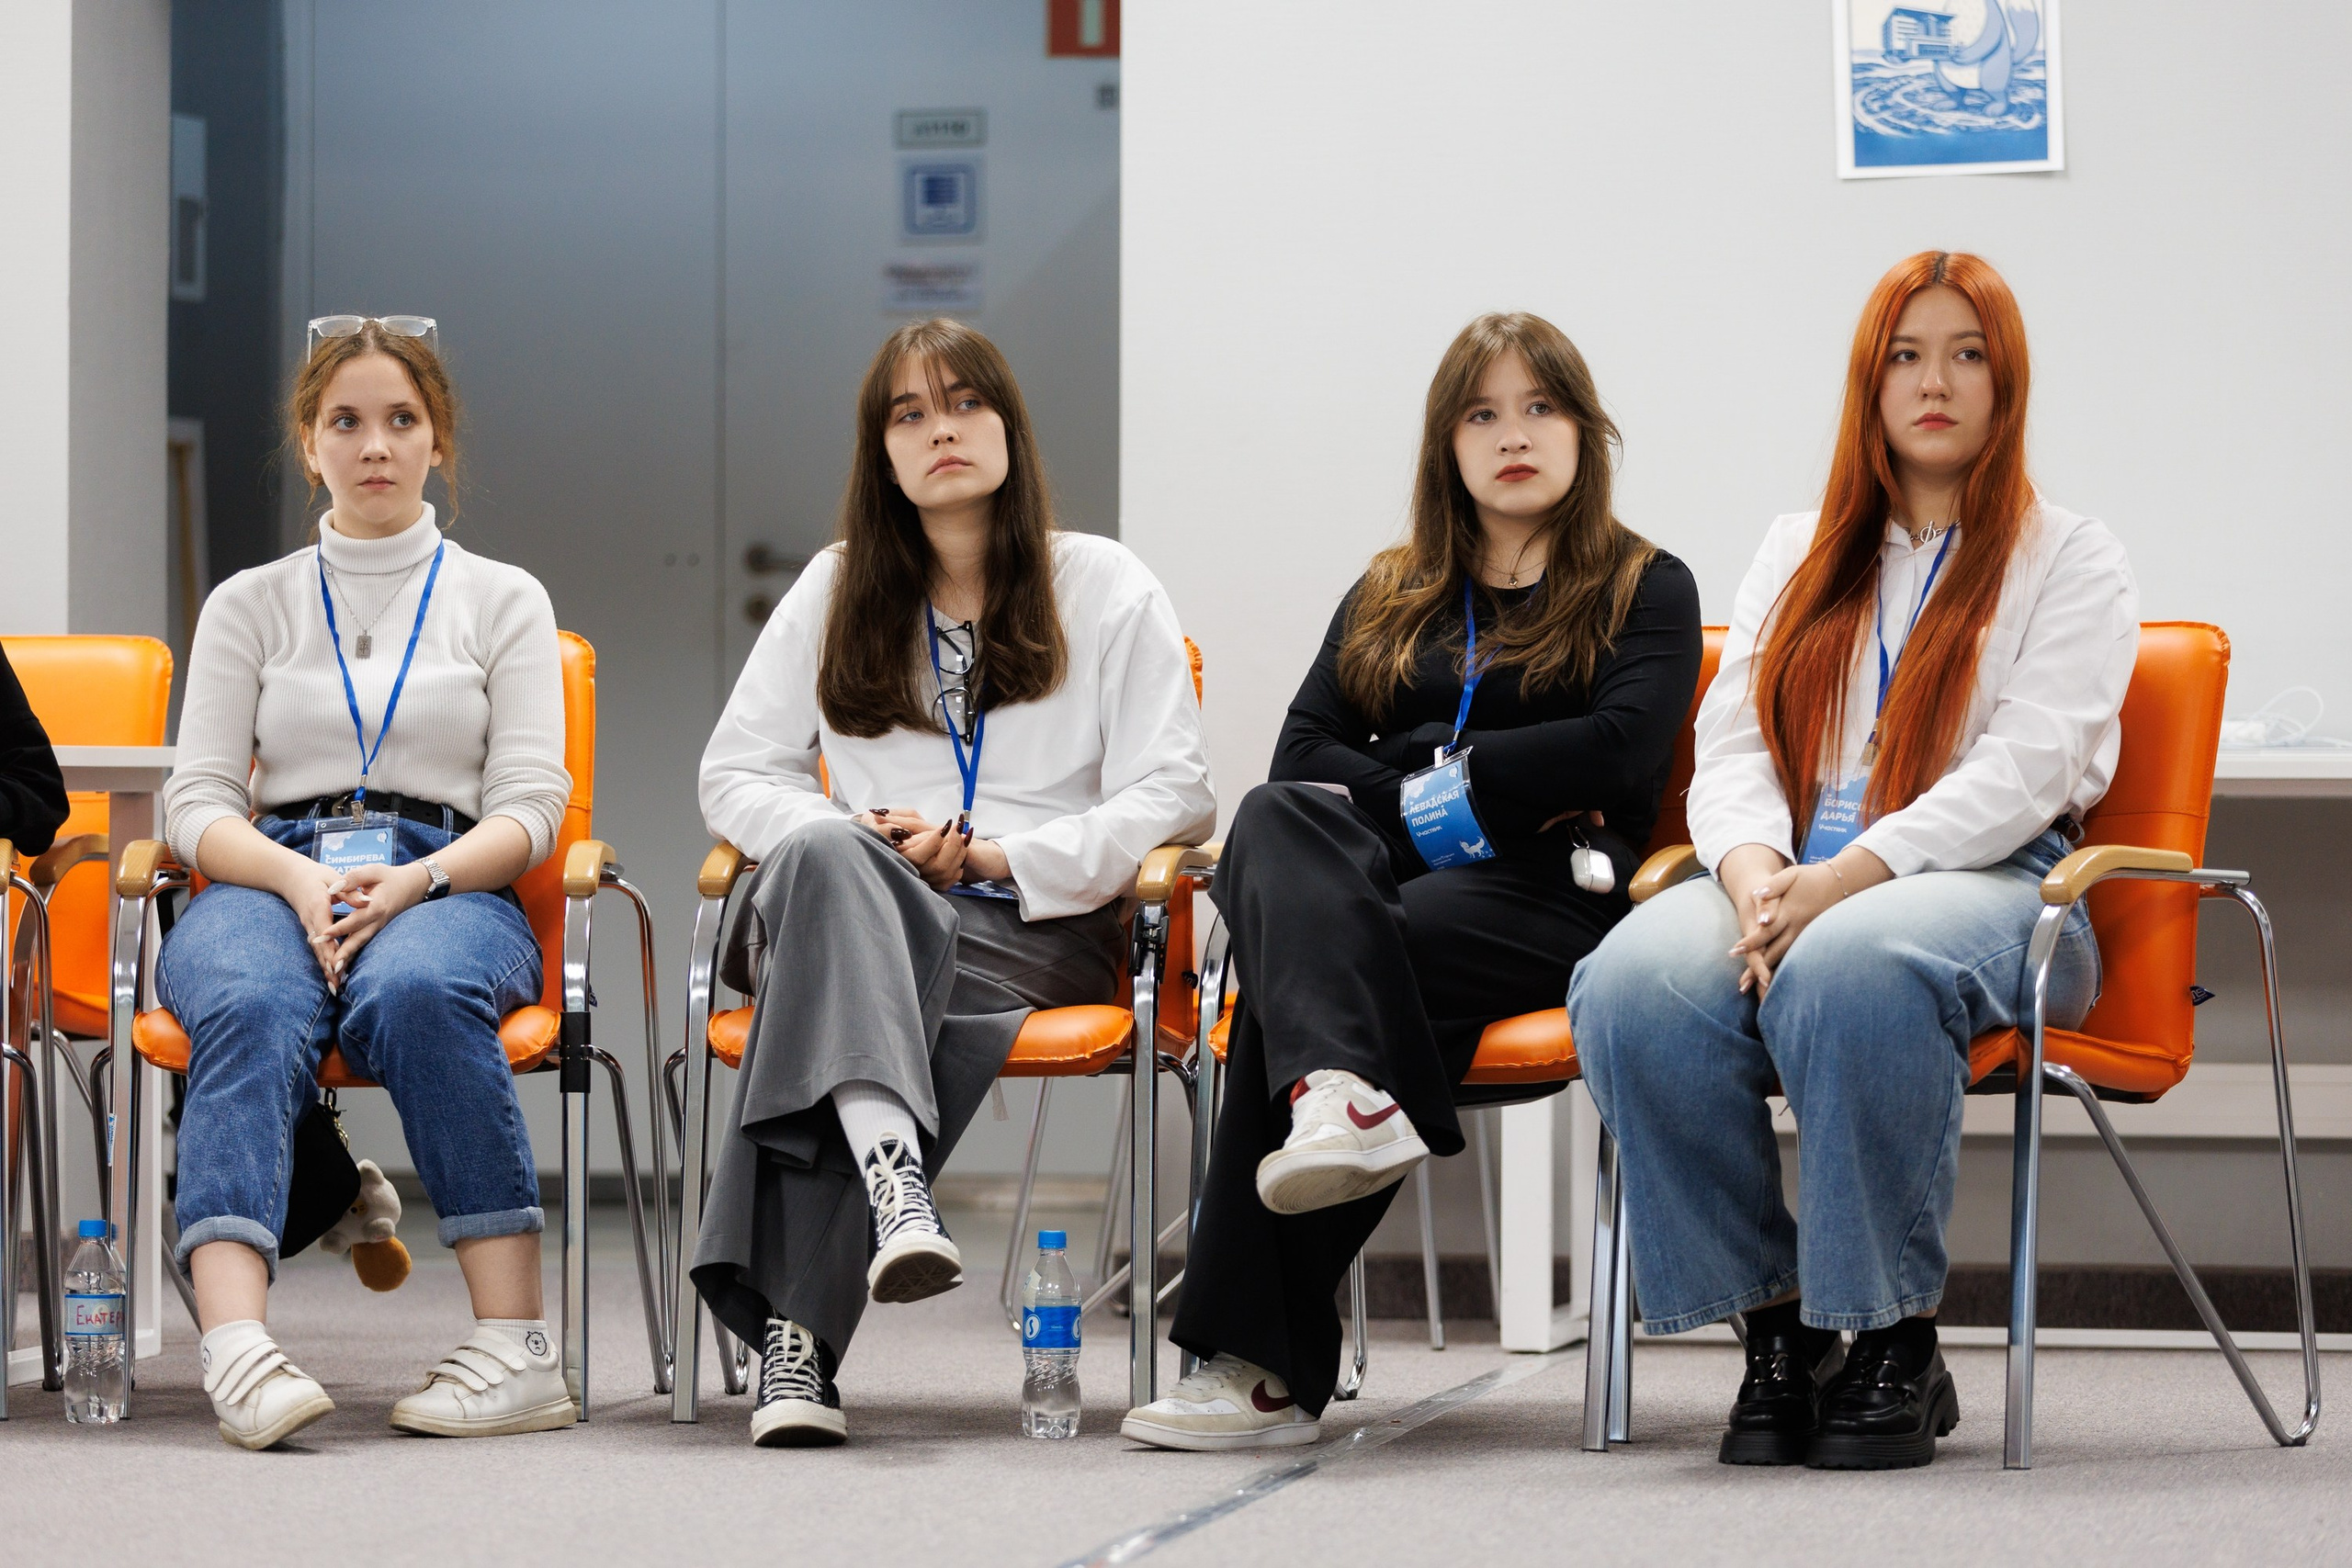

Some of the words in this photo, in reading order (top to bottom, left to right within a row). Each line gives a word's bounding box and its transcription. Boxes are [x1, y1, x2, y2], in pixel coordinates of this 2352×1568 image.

[1409, 789, 1460, 815] ЛЕВАДСКАЯ
[1411, 807, 1448, 827] ПОЛИНА
[1820, 810, 1856, 823] ДАРЬЯ
[325, 853, 386, 864] СИМБИРЕВА
